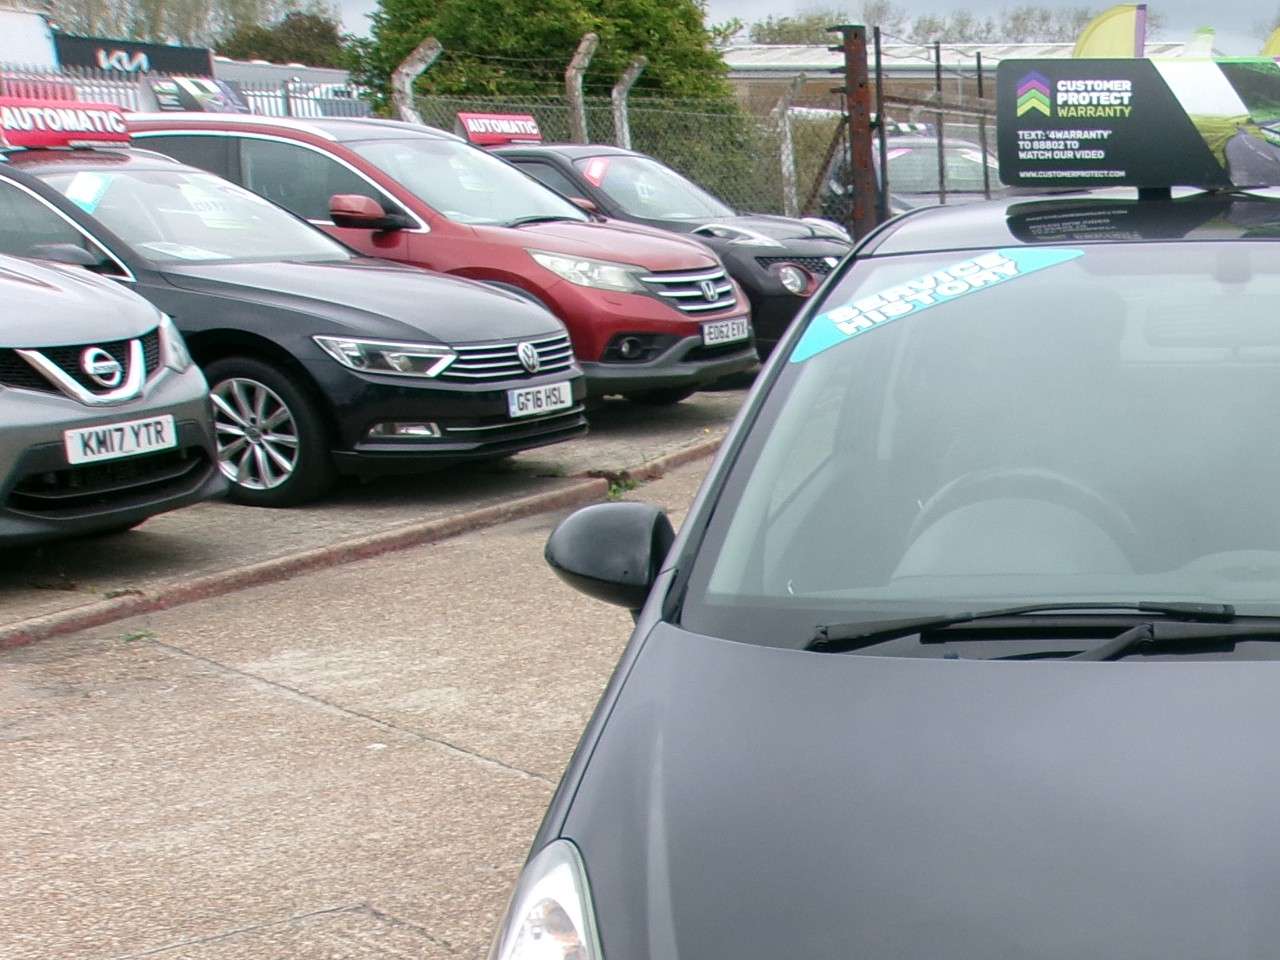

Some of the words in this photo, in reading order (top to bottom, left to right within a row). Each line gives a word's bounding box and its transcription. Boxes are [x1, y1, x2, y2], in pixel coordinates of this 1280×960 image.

[1056, 79, 1132, 91] CUSTOMER
[1056, 92, 1132, 105] PROTECT
[1056, 106, 1132, 117] WARRANTY
[1, 106, 127, 133] AUTOMATIC
[467, 118, 539, 134] AUTOMATIC
[1017, 130, 1046, 140] TEXT:
[1018, 140, 1031, 149] TO
[1066, 140, 1080, 149] TO
[1018, 150, 1052, 159] WATCH
[1053, 150, 1074, 159] OUR
[1075, 150, 1105, 159] VIDEO
[1019, 170, 1126, 178] WWW.CUSTOMERPROTECT.COM
[827, 250, 1013, 323] SERVICE
[835, 258, 1021, 336] HISTORY
[545, 386, 566, 407] HSL
[80, 427, 125, 457] KM17
[130, 421, 166, 448] YTR
